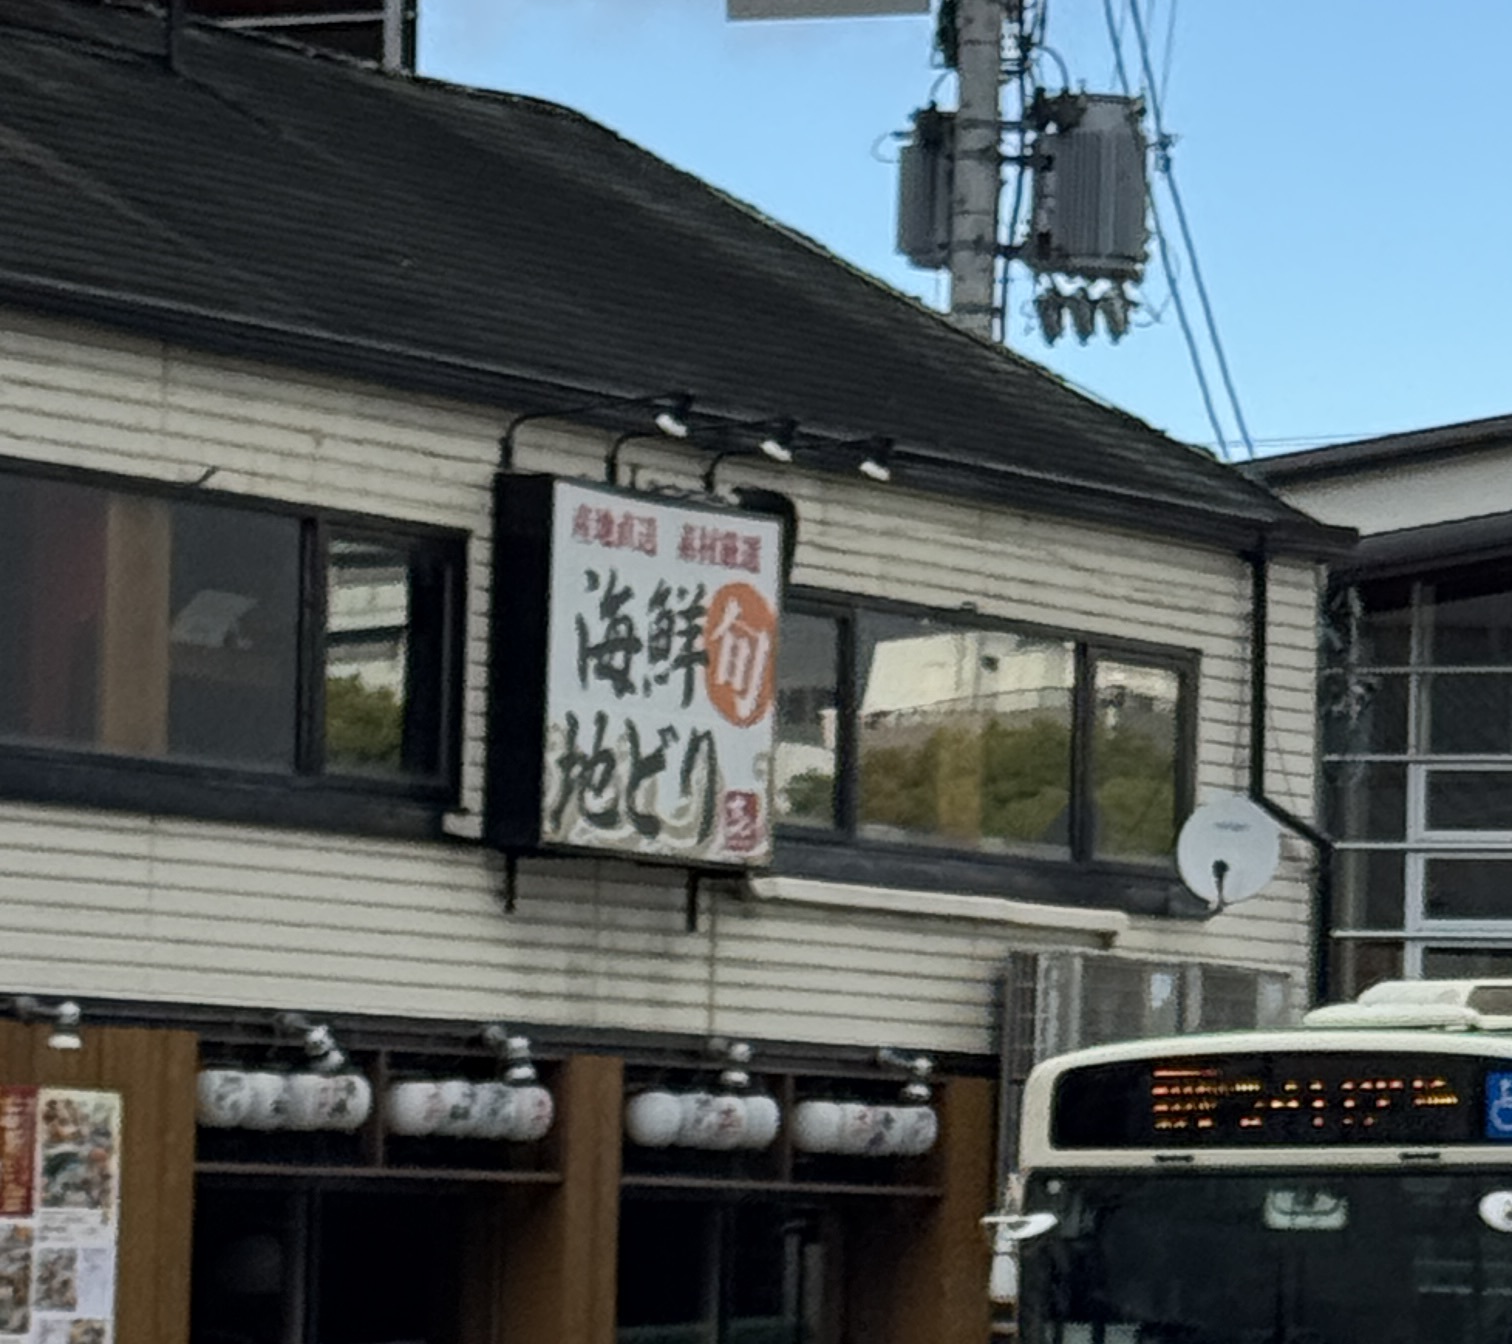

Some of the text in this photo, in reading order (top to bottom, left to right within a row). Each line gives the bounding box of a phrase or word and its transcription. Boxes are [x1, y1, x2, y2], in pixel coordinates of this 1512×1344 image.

[575, 568, 708, 709] 海鮮
[709, 596, 770, 720] 旬
[551, 710, 716, 847] 地どり
